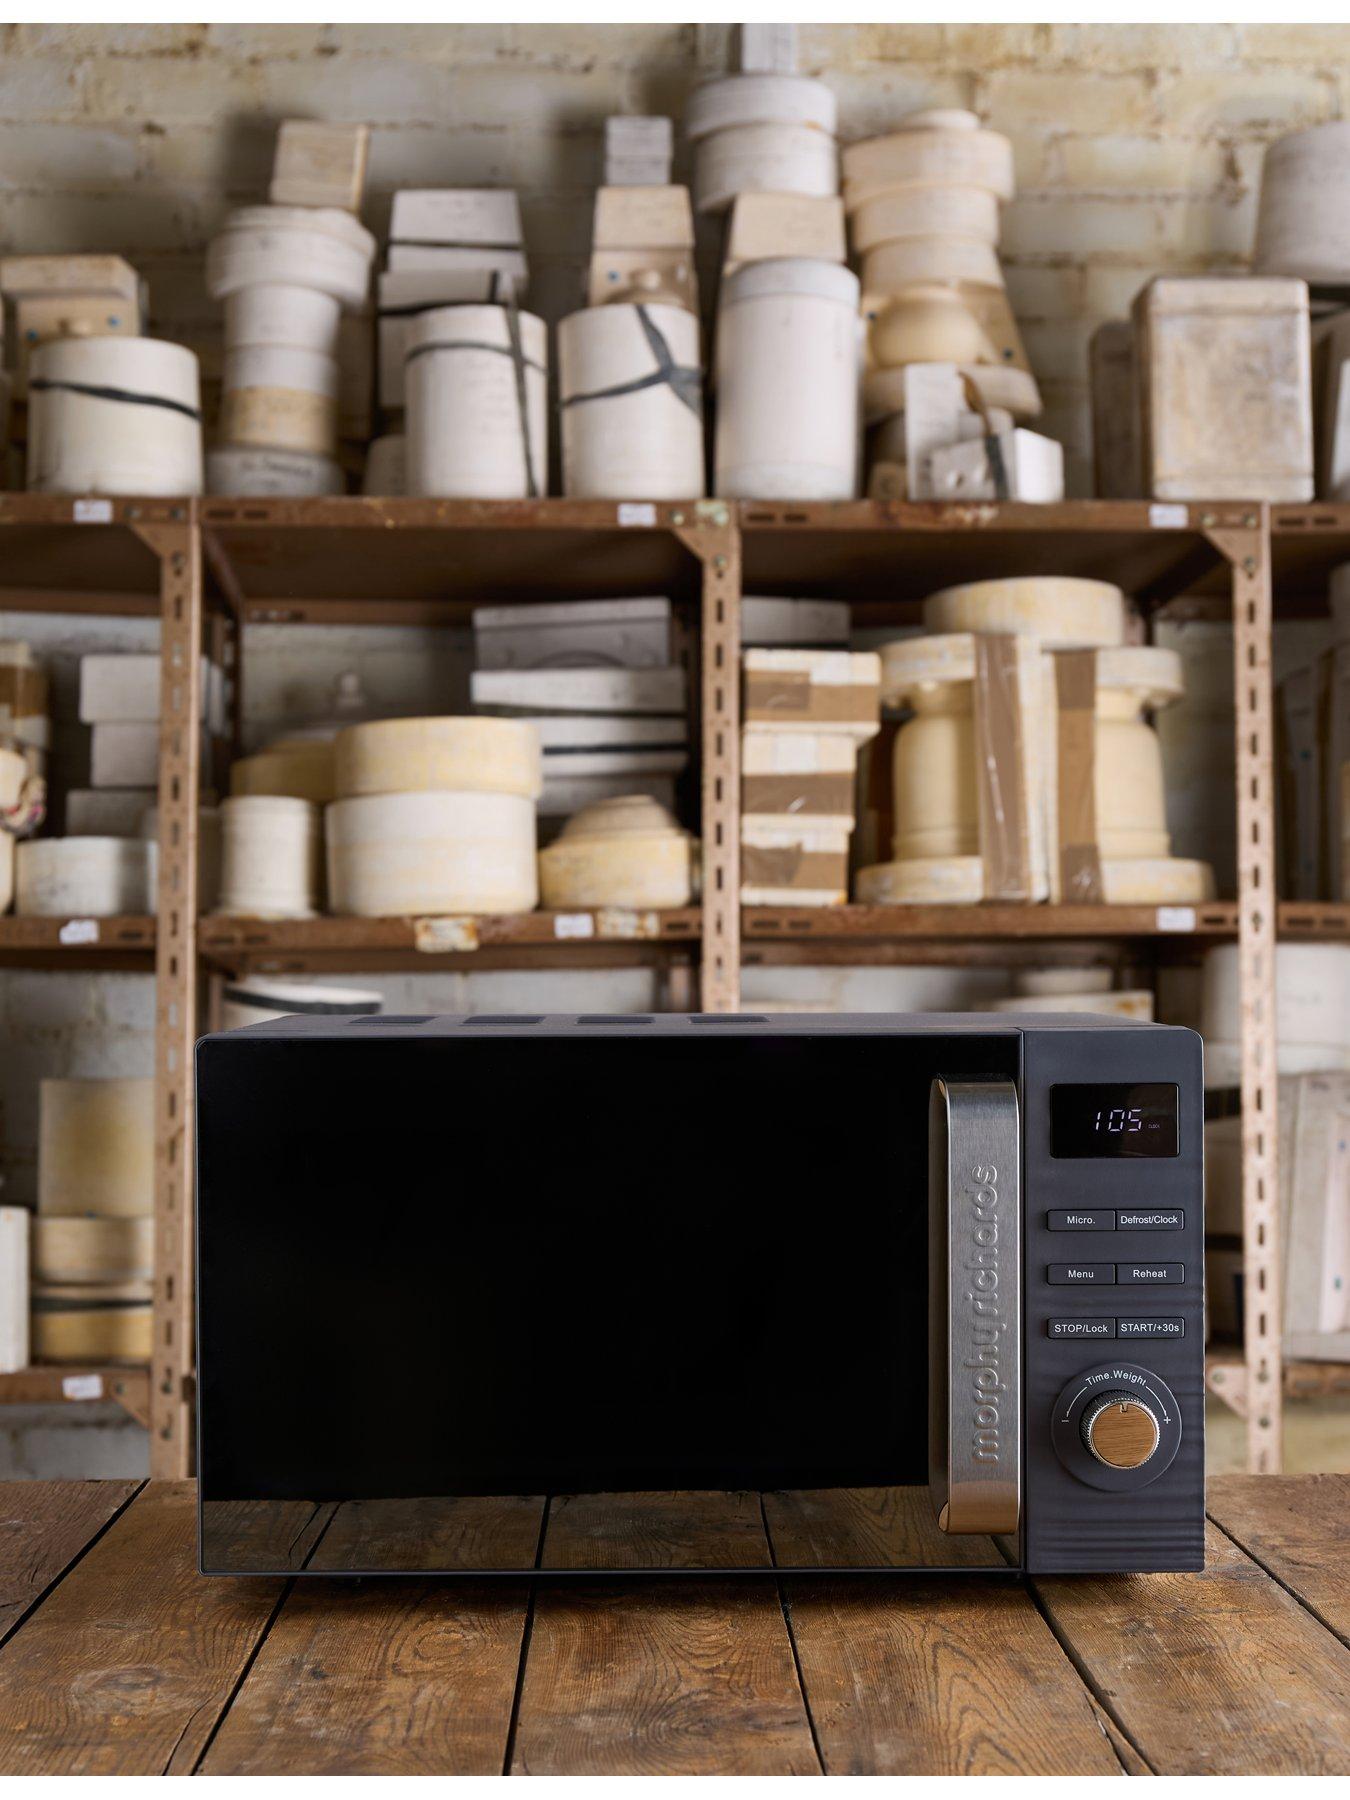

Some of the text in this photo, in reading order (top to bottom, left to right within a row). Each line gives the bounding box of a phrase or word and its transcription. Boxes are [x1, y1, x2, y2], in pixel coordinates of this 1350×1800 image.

[1095, 1109, 1142, 1132] 105
[1066, 1216, 1096, 1225] Micro.
[1120, 1215, 1179, 1224] Defrost/Clock
[1068, 1269, 1094, 1279] Menu
[1133, 1269, 1167, 1278] Reheat
[1054, 1324, 1108, 1333] STOP/Lock
[1120, 1323, 1180, 1332] START/+30s
